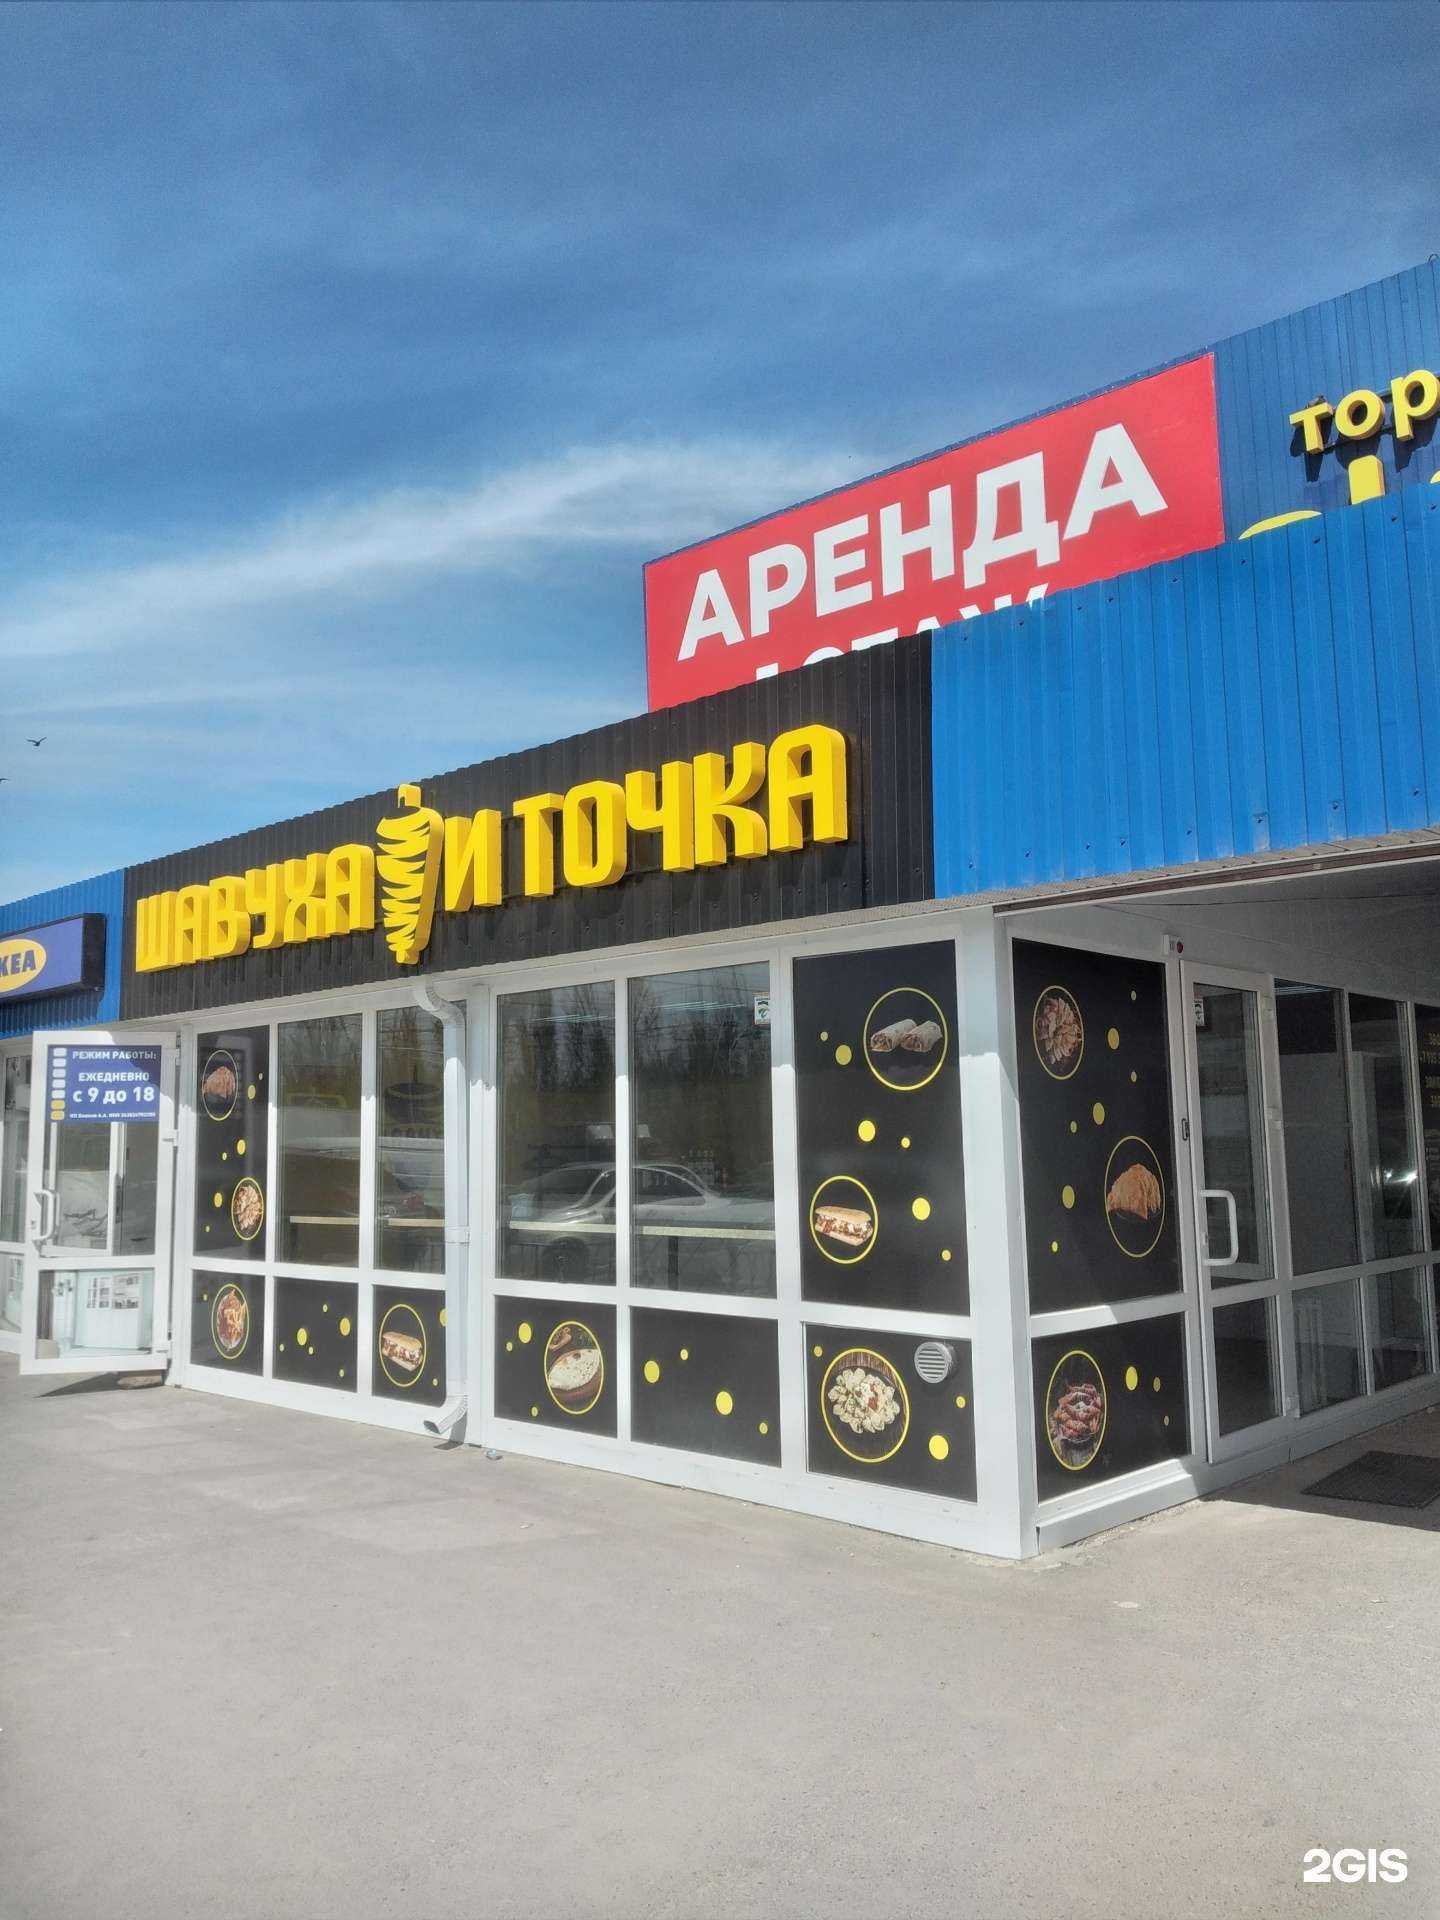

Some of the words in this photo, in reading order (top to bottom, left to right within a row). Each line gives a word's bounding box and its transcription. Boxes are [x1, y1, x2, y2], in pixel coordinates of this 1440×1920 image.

[677, 423, 1168, 662] АРЕНДА
[135, 843, 375, 973] ШАВУХА
[444, 808, 502, 912] И
[513, 723, 848, 897] ТОЧКА
[72, 1050, 111, 1060] РЕЖИМ
[112, 1050, 157, 1060] РАБОТЫ:
[78, 1072, 150, 1083] ЕЖЕДНЕВНО
[87, 1087, 99, 1103] 9
[102, 1090, 127, 1105] до
[133, 1086, 155, 1102] 18
